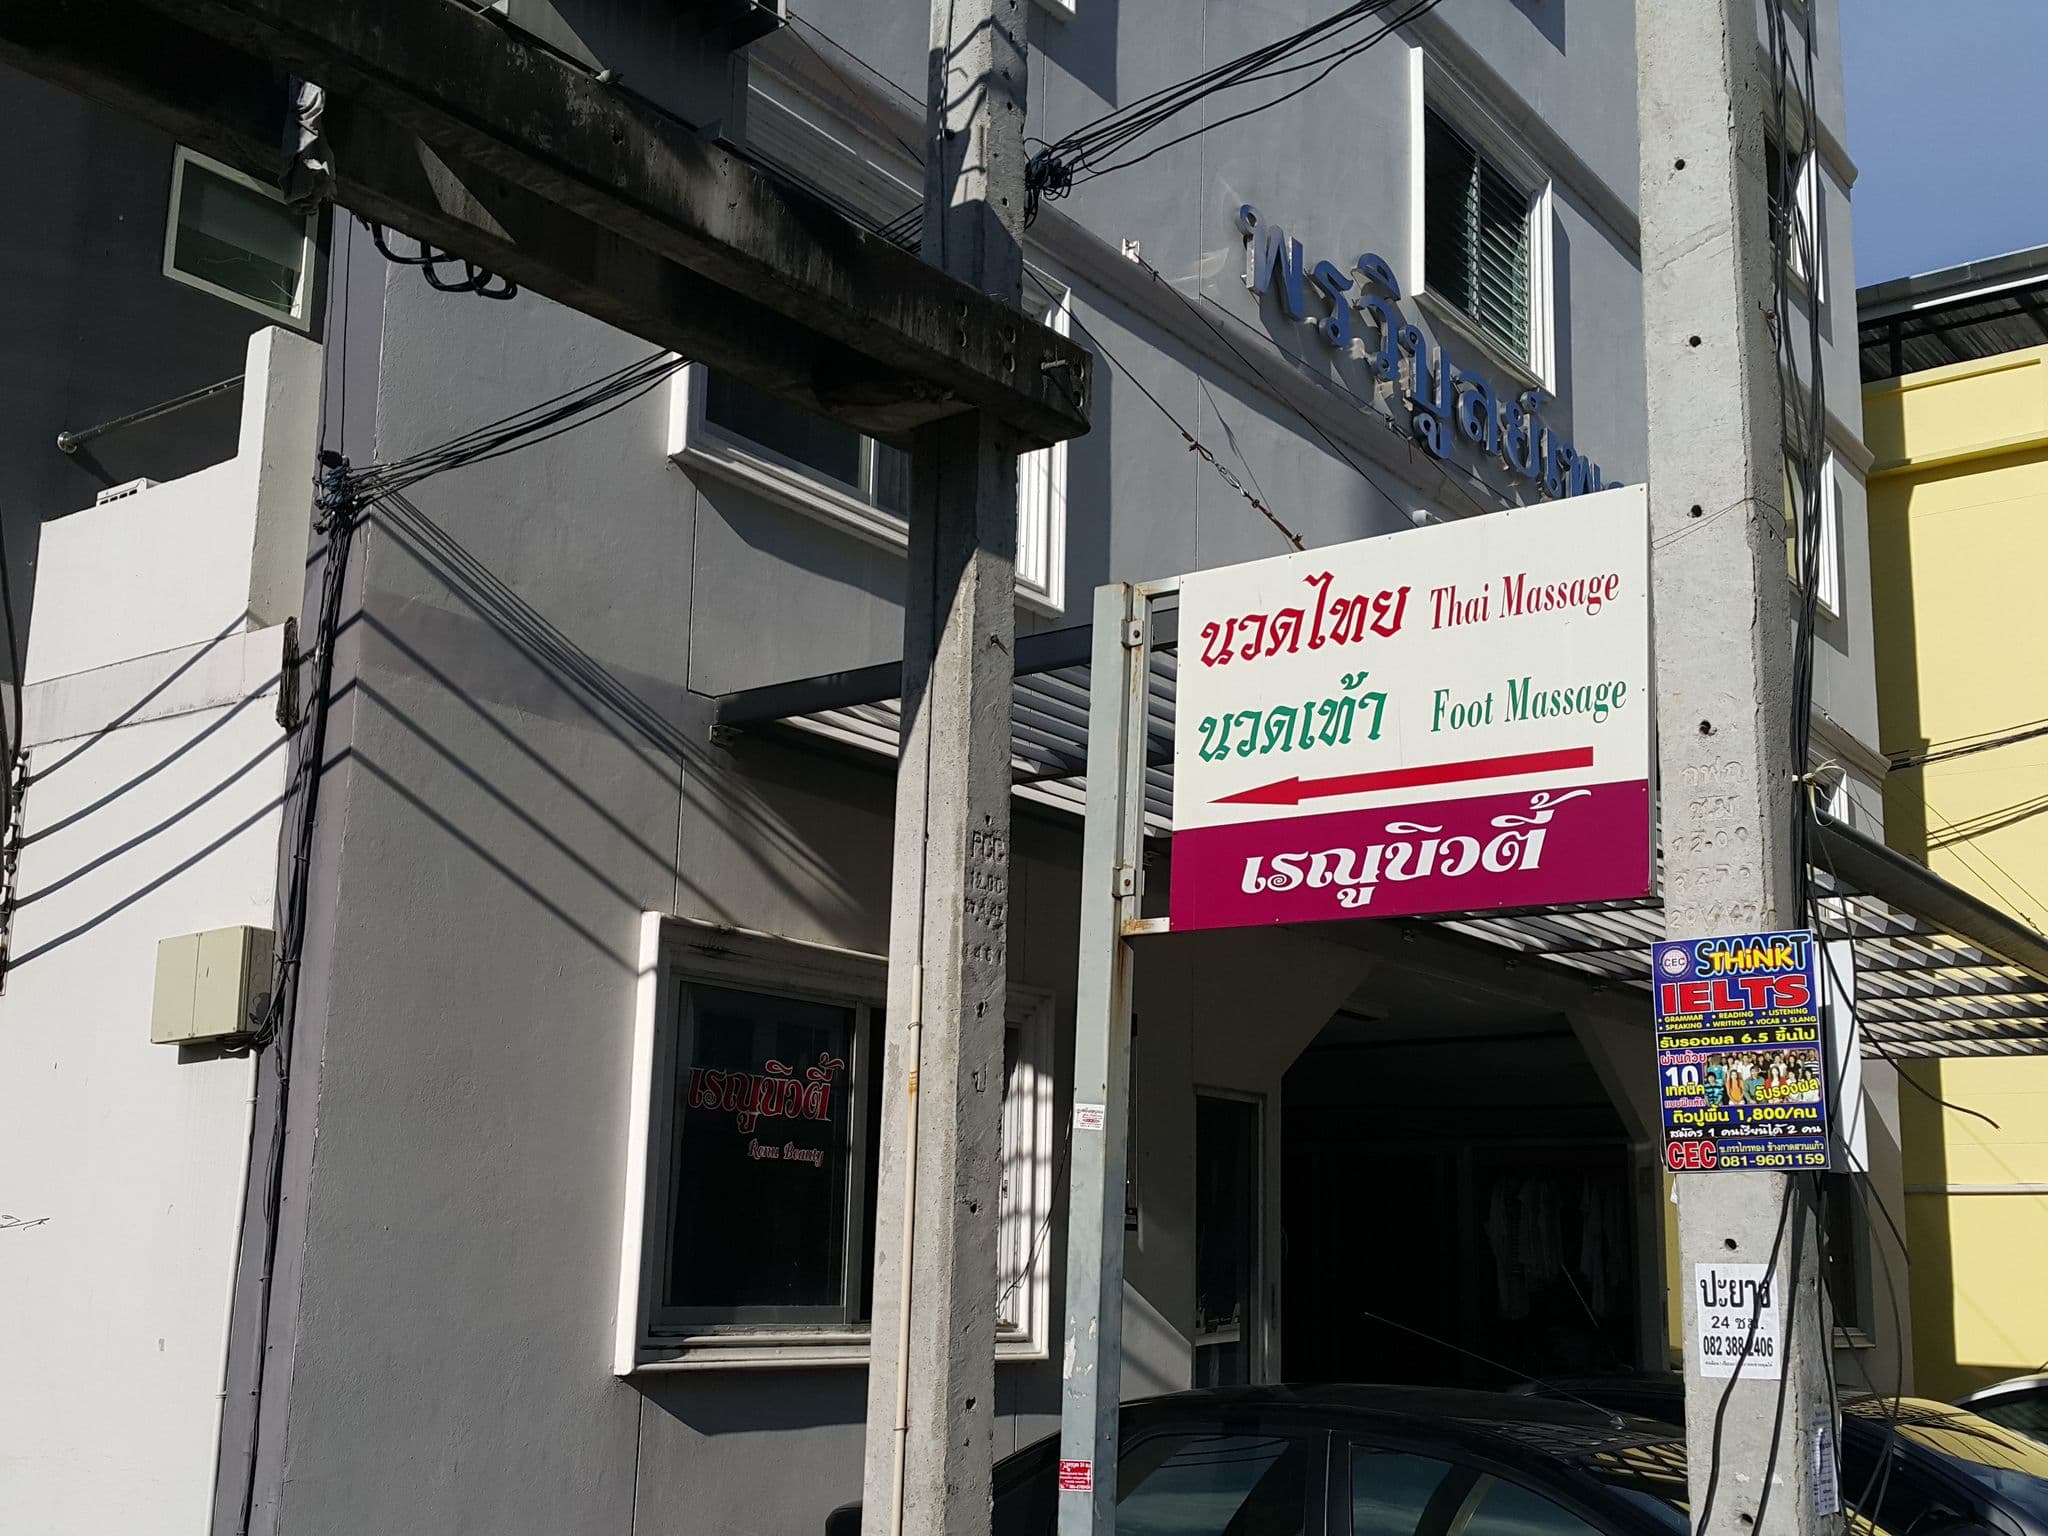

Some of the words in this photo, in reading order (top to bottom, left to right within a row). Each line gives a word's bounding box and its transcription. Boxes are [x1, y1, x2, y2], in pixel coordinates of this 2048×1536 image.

[1200, 571, 1411, 667] นวดไทย
[1430, 583, 1490, 630] Thai
[1499, 573, 1620, 616] Massage
[1198, 671, 1388, 762] นวดเท้า
[1430, 689, 1493, 732] Foot
[1504, 676, 1627, 723] Massage
[1241, 789, 1591, 908] เรณูบิวตี้
[1664, 957, 1685, 967] CEC
[1661, 974, 1811, 1015] IELTS
[1664, 1014, 1703, 1023] GRAMMAR
[1718, 1011, 1754, 1019] READING
[1768, 1007, 1808, 1016] LISTENING
[1665, 1022, 1702, 1031] SPEAKING
[1712, 1019, 1746, 1028] WRITING
[1789, 1015, 1816, 1023] SLANG
[1660, 1035, 1734, 1048] รับรองผล
[1741, 1032, 1769, 1044] 6.5
[1775, 1026, 1816, 1042] ขึ้นไป
[1665, 1065, 1699, 1087] 10
[1665, 1082, 1705, 1097] เทคนิค
[1755, 1078, 1819, 1102] รับรองผล
[1673, 1104, 1730, 1126] ติวปูพื้น
[1737, 1107, 1818, 1124] 1,800/คน
[1670, 1127, 1703, 1138] สมัคร
[1708, 1128, 1715, 1137] 1
[1787, 1125, 1798, 1134] 2
[1801, 1125, 1822, 1133] คน
[1668, 1140, 1717, 1169] CEC
[1720, 1153, 1825, 1168] 081-9601159
[1711, 1316, 1730, 1329] 24
[1703, 1335, 1722, 1356] 082
[1725, 1336, 1744, 1356] 388
